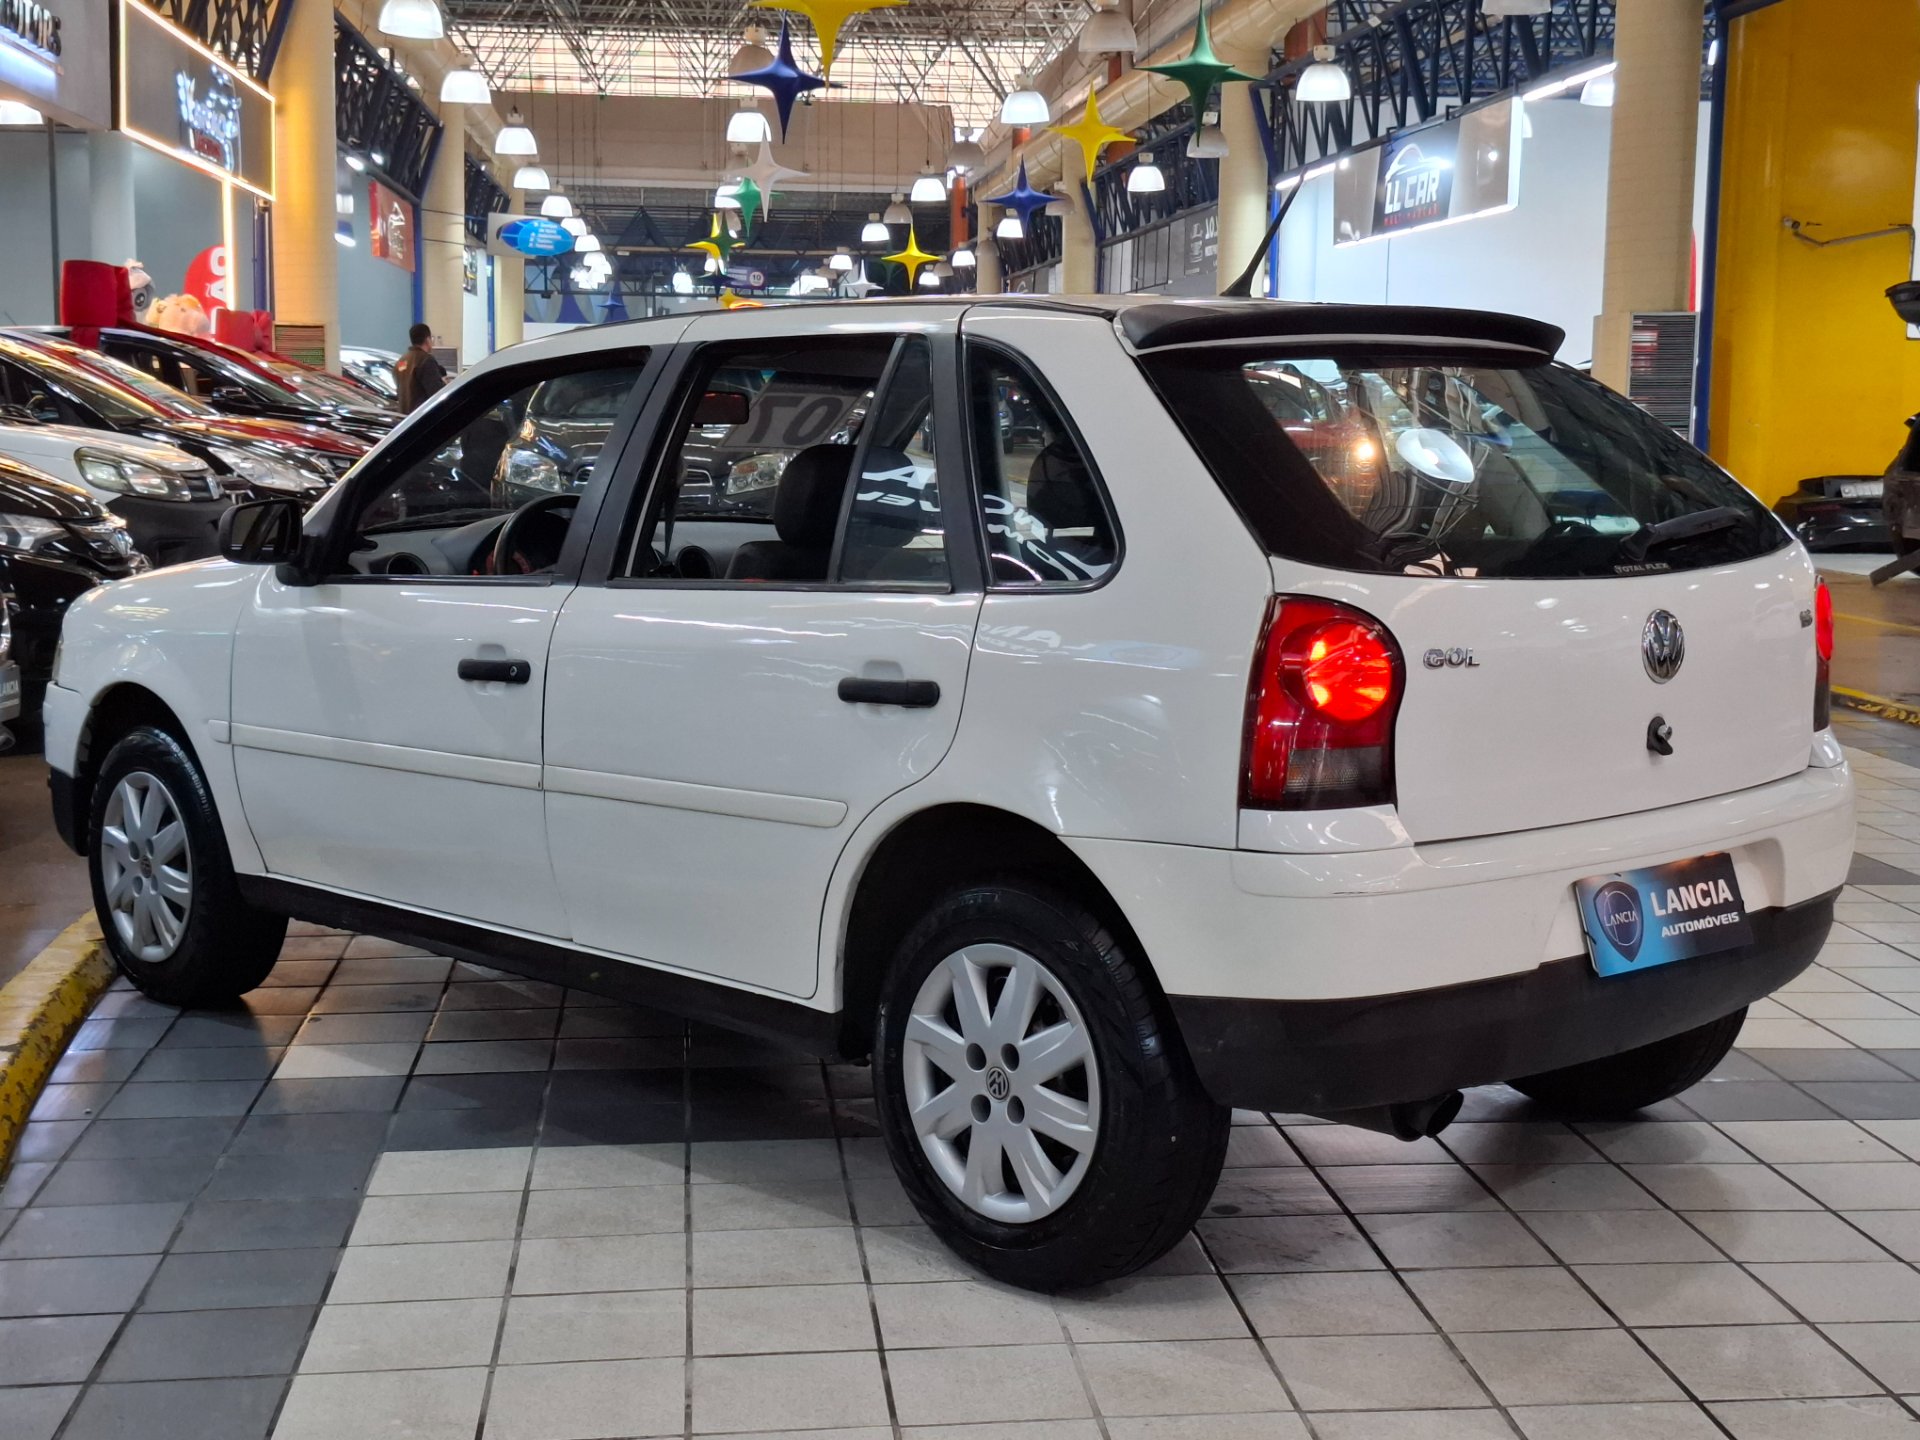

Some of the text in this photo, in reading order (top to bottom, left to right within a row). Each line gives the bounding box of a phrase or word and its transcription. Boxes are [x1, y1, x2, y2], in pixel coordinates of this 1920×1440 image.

[1384, 169, 1440, 214] LL CAR
[1423, 647, 1480, 670] GOL
[1650, 878, 1734, 917] LANCIA
[1604, 910, 1638, 927] LANCIA
[1661, 911, 1740, 938] AUTOMÓVEIS
